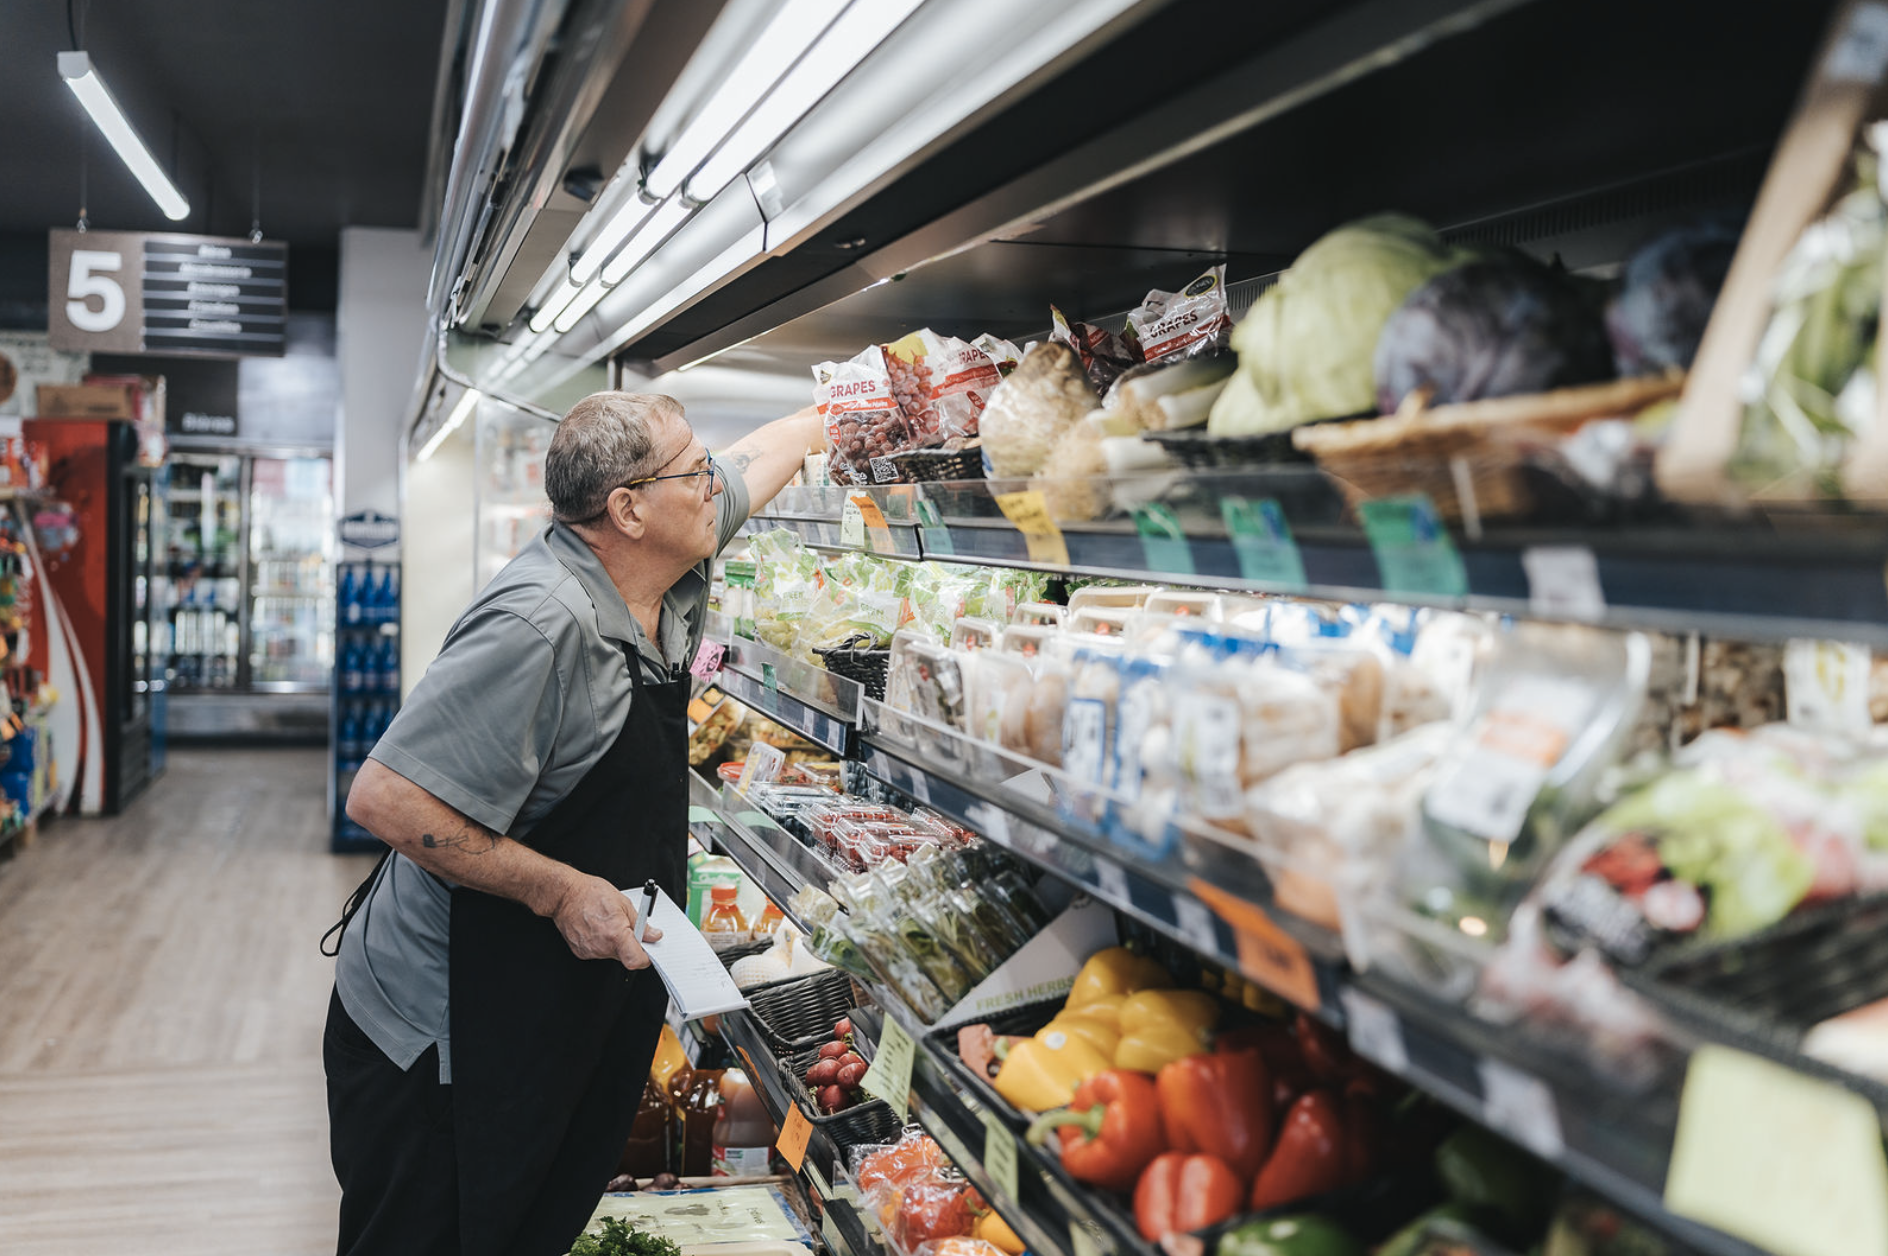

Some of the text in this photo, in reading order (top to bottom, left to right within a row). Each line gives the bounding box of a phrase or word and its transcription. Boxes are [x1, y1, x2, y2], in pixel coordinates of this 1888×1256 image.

[66, 249, 126, 332] 5
[830, 379, 876, 398] GRAPES
[975, 988, 1024, 1011] FRESH
